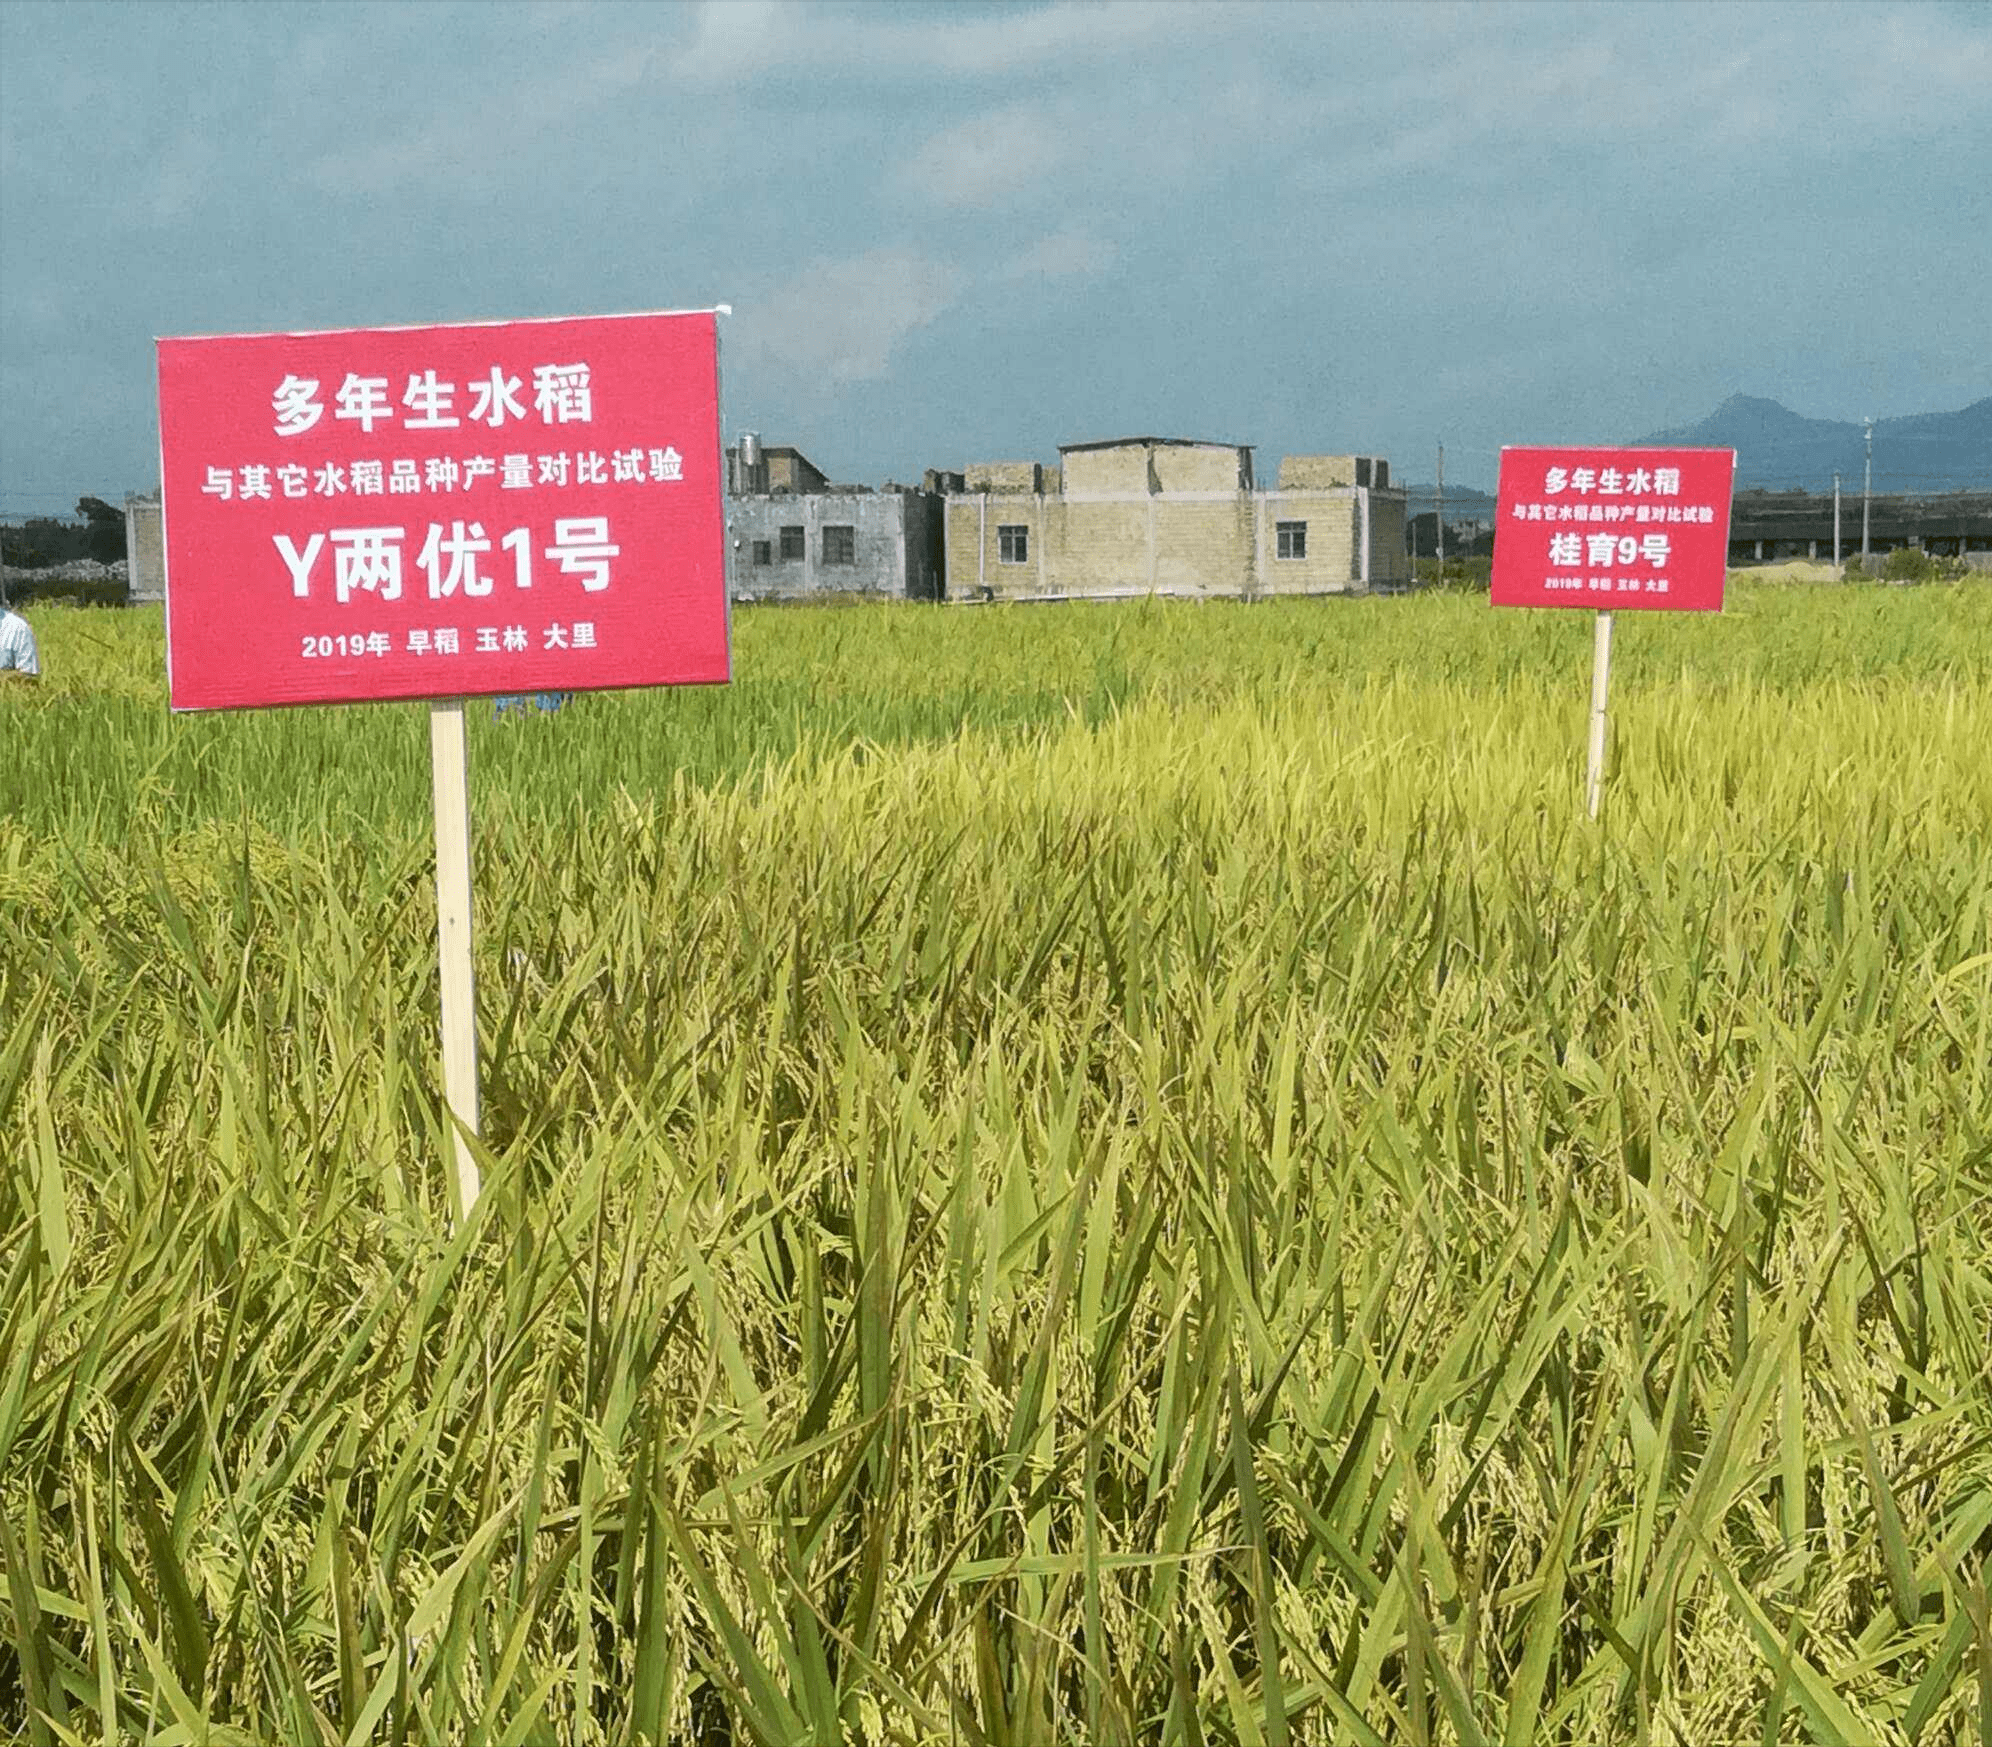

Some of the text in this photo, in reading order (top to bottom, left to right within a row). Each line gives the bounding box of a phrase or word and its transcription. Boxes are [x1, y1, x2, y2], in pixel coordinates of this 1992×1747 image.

[271, 362, 593, 437] 多年生水稻
[201, 445, 684, 501] 与其它水稻品种产量对比试验
[1544, 466, 1680, 495] 多年生水稻
[1512, 503, 1714, 523] 与其它水稻品种产量对比试验
[272, 516, 620, 603] Y两优1号
[1548, 531, 1672, 568] 桂育9号
[301, 622, 598, 658] 2019年 早稻 玉林 大里
